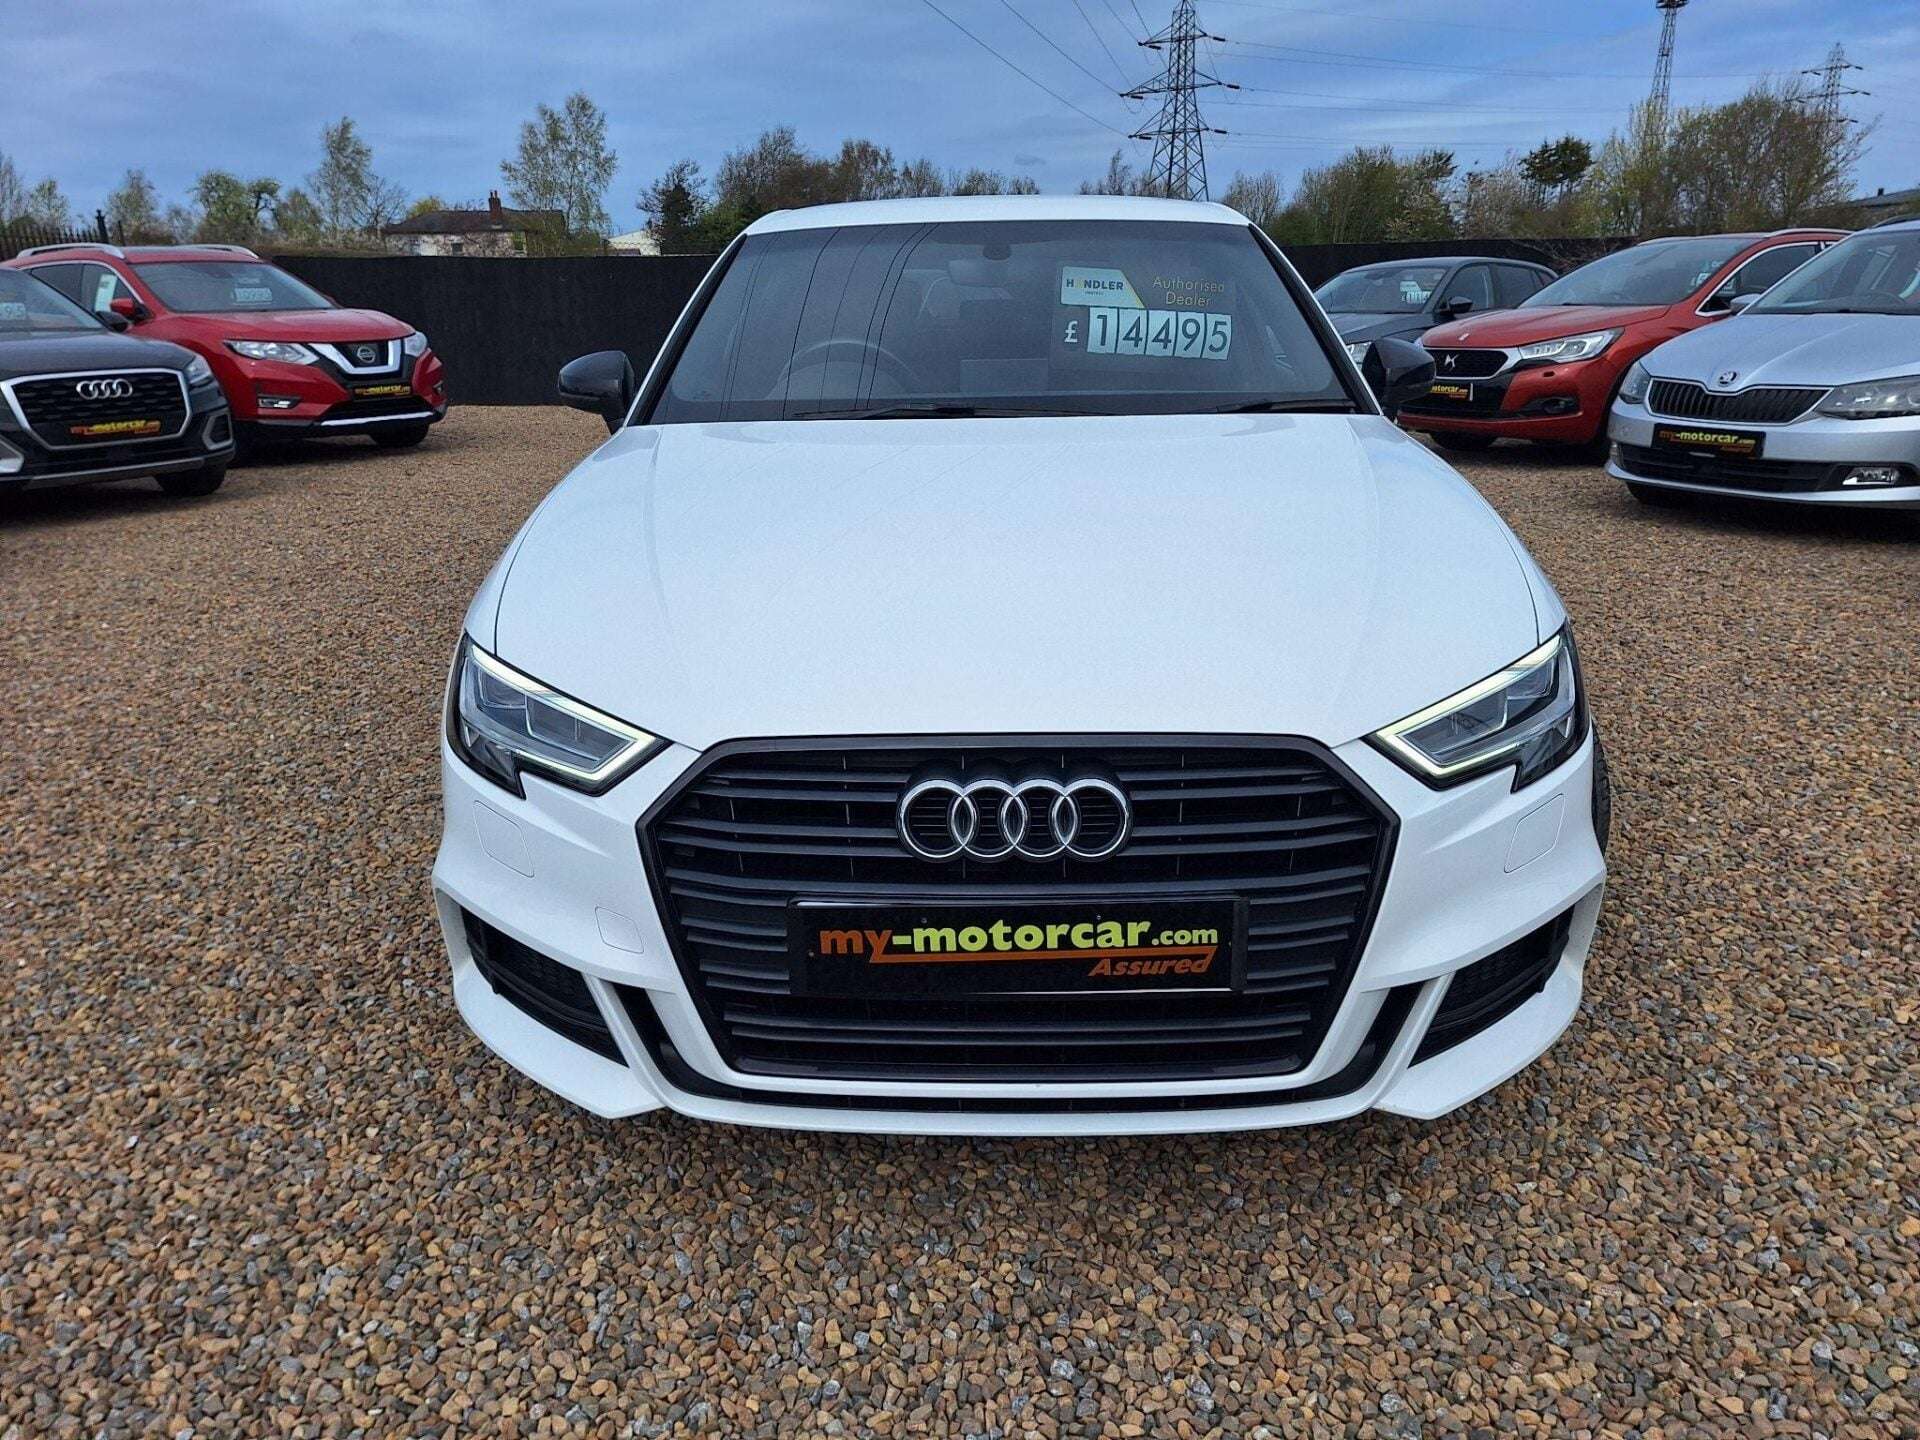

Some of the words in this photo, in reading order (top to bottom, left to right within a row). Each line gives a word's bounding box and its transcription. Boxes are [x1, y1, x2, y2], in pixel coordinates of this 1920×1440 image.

[1152, 276, 1225, 292] Authorised
[1166, 291, 1209, 306] Dealer
[1097, 314, 1228, 353] 14495
[819, 919, 1218, 962] my-motorcar.com
[1089, 954, 1213, 976] Assured
